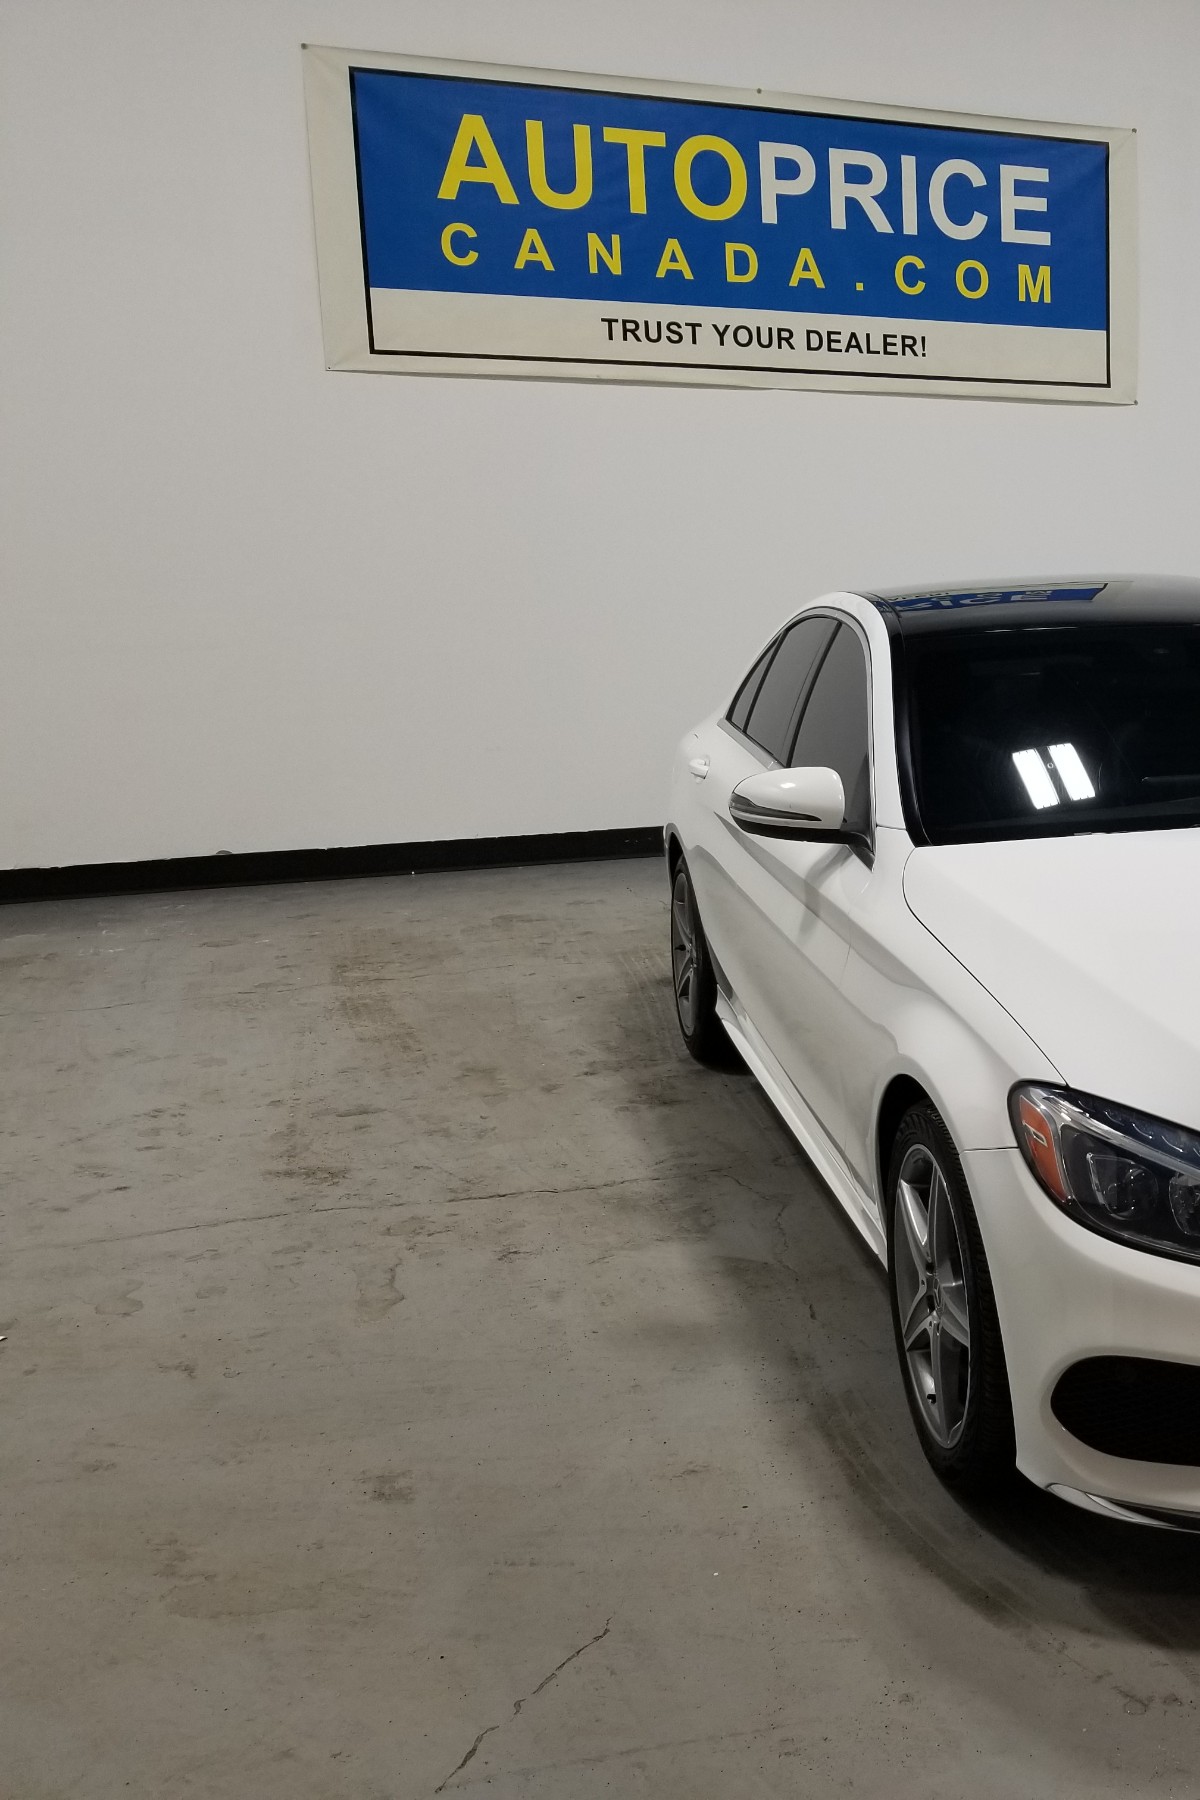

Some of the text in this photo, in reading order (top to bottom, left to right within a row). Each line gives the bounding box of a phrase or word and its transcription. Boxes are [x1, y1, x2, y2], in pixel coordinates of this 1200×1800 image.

[437, 112, 1052, 246] AUTOPRICE
[601, 317, 927, 358] TRUST YOUR DEALER!
